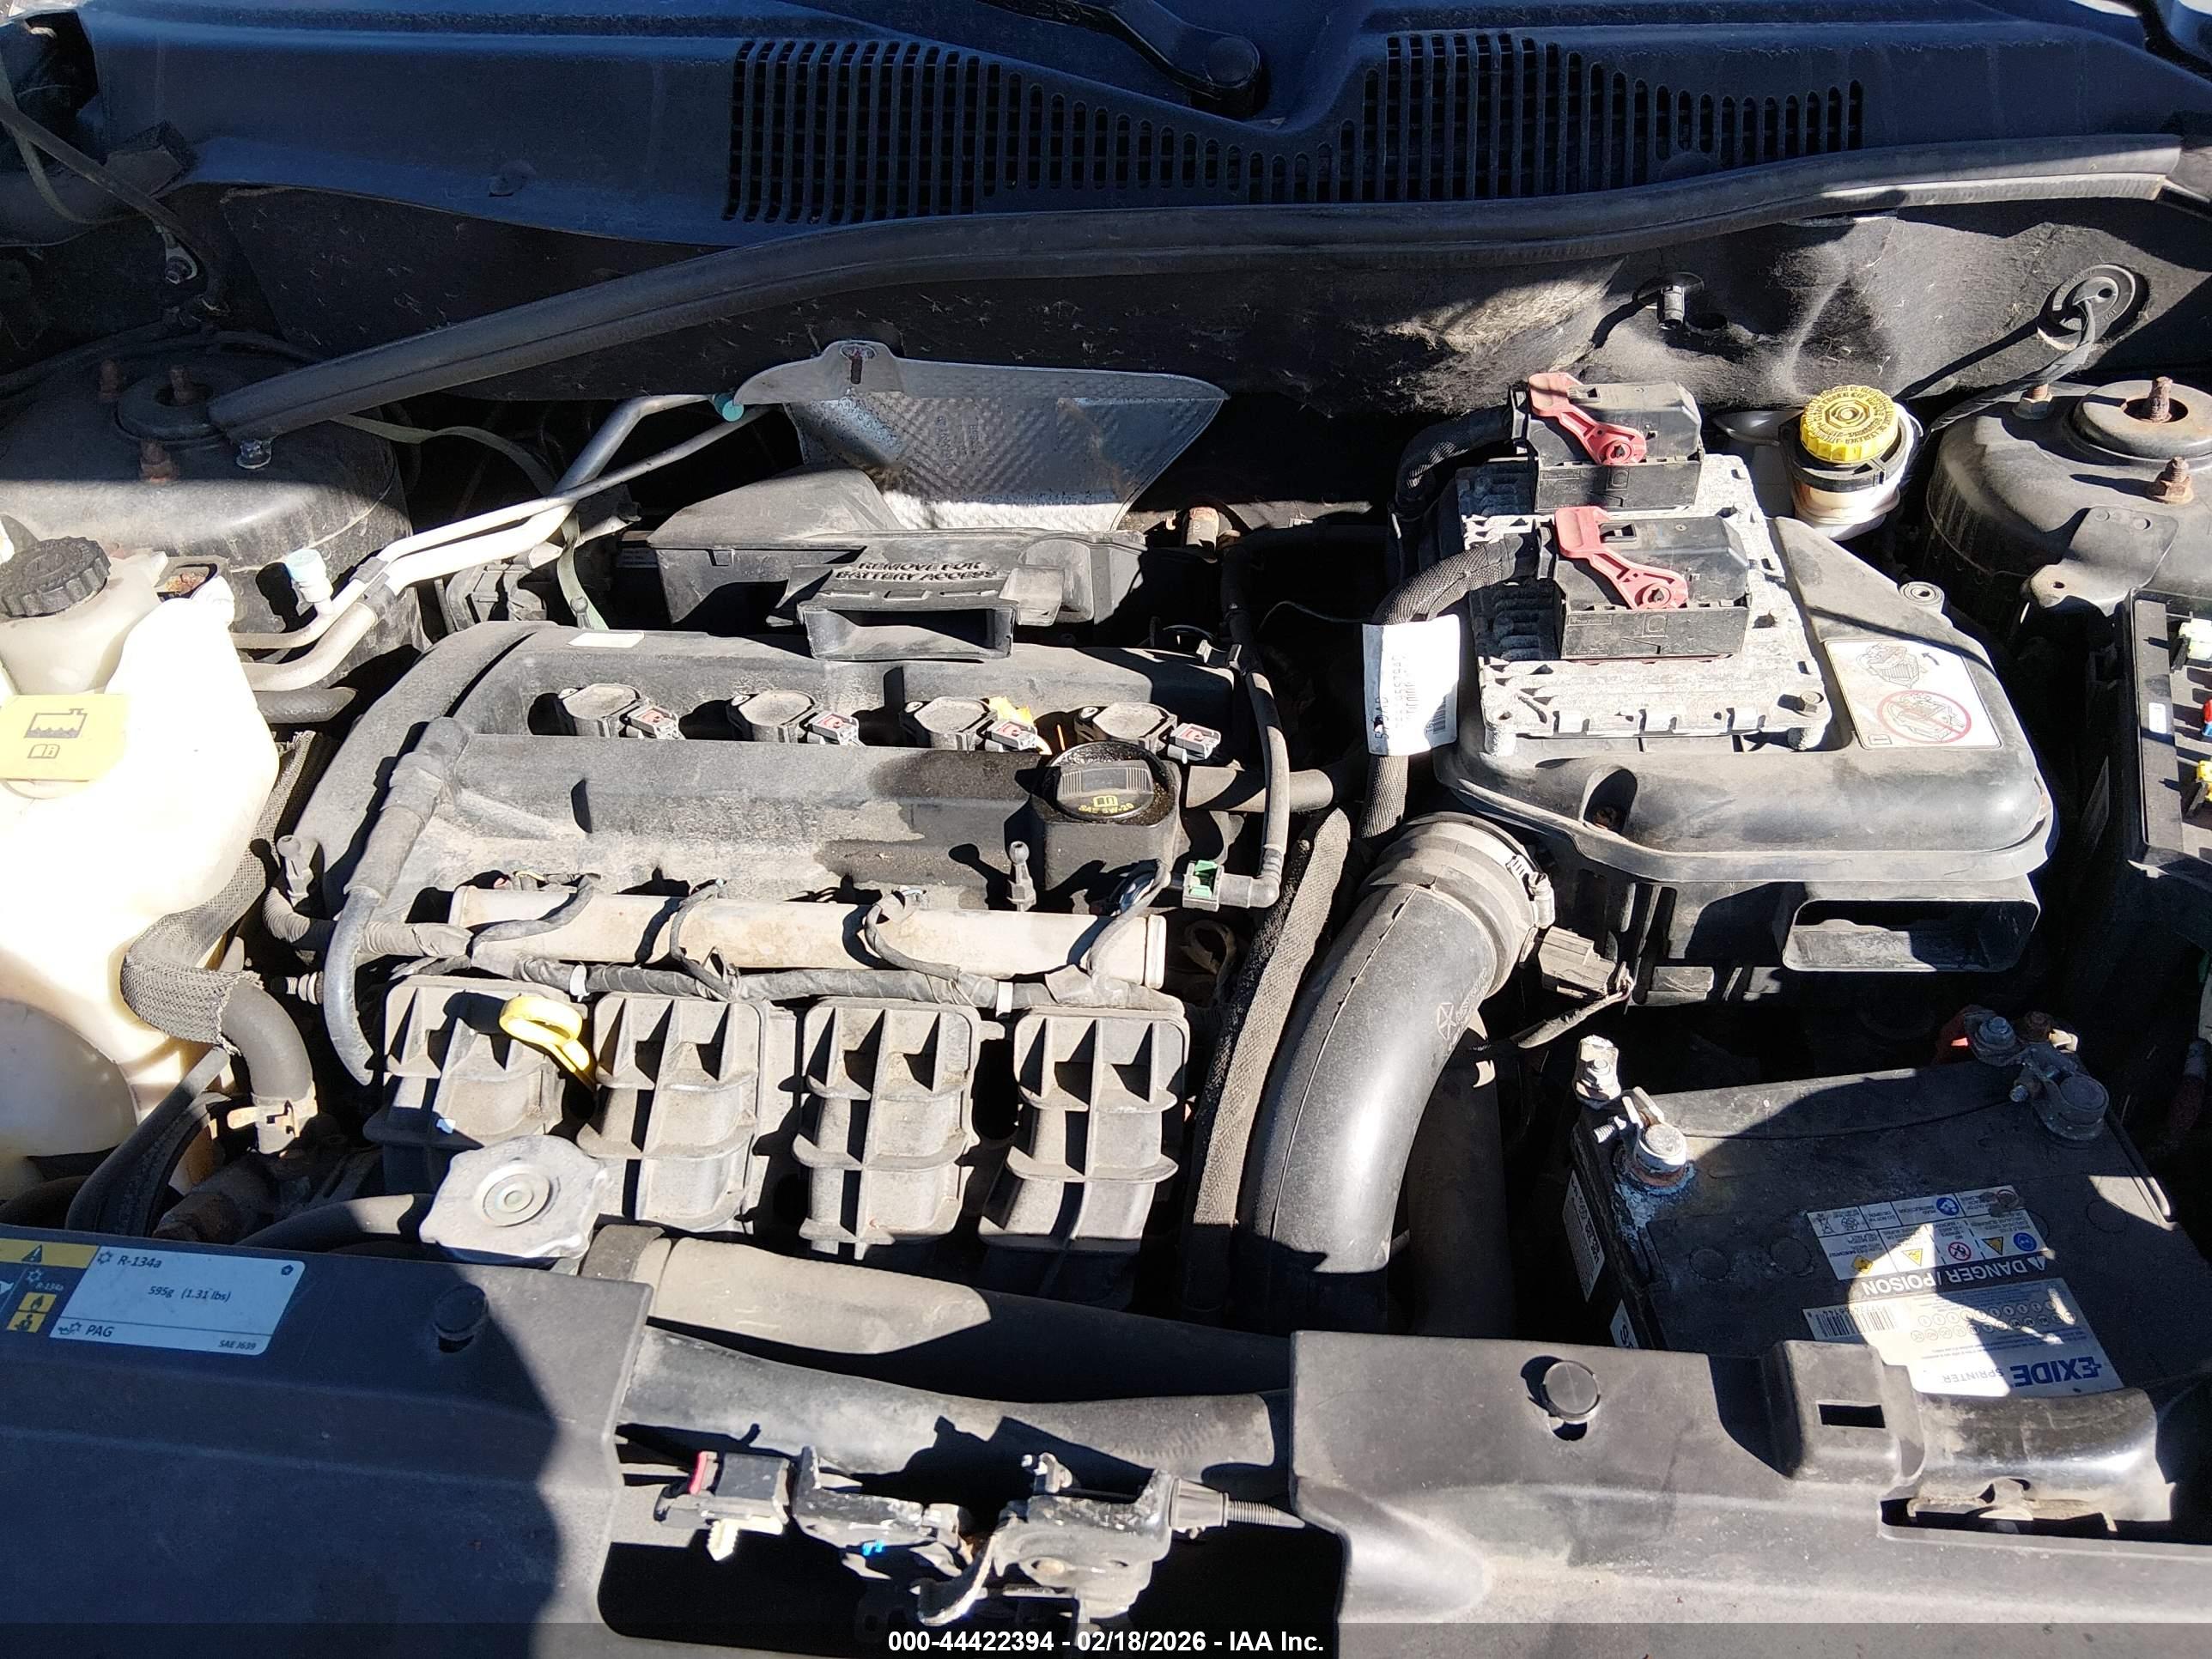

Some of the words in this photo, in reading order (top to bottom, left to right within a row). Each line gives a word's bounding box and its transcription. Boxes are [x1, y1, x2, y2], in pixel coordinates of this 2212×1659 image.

[859, 562, 939, 571] REMOVE
[941, 562, 981, 571] FOR
[836, 570, 915, 581] BATTERY
[920, 569, 998, 581] ACCESS
[1078, 805, 1100, 814] SAE
[117, 1254, 162, 1269] R-134a
[1947, 1259, 2027, 1283] DANGER
[1861, 1273, 1936, 1297] POISON
[148, 1285, 174, 1299] 595g
[181, 1287, 209, 1300] (1.31
[210, 1290, 232, 1303] lbs)
[85, 1324, 115, 1338] PAG
[219, 1339, 234, 1350] SAE
[235, 1340, 257, 1352] J639
[1942, 1366, 2005, 1384] SPRINTER
[2009, 1356, 2101, 1389] EXIDE
